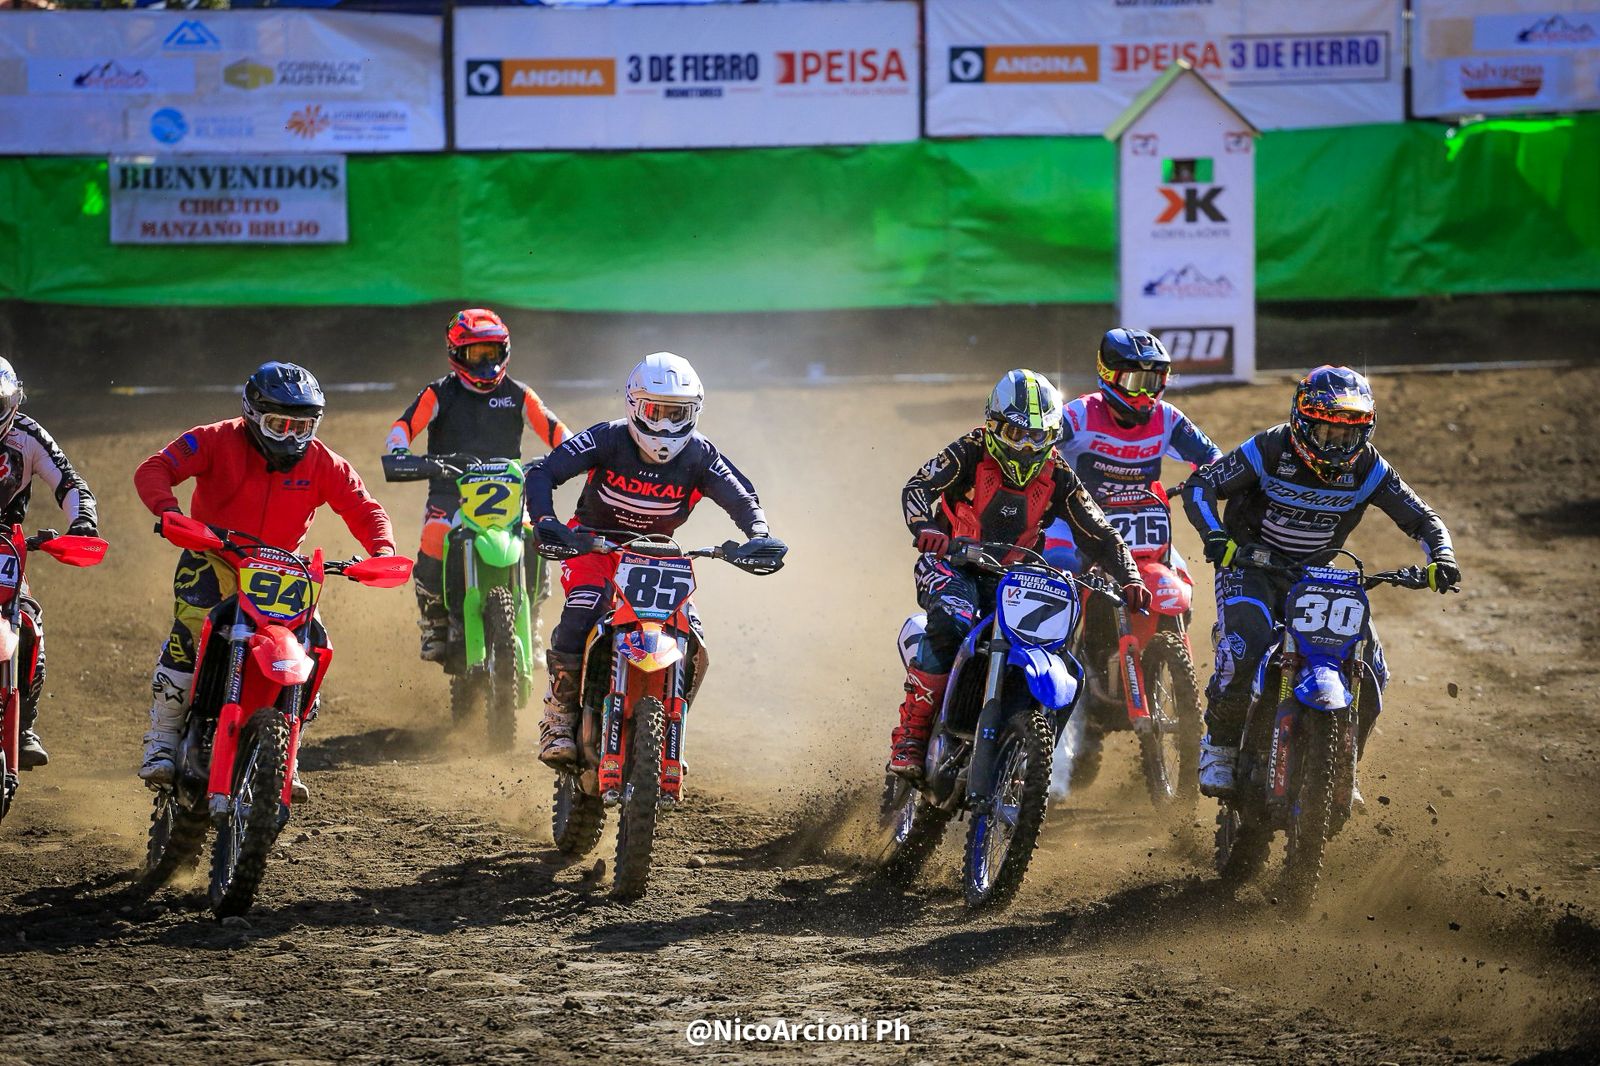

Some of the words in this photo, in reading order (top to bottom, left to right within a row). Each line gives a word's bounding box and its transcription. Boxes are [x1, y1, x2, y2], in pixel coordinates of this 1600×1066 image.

[627, 54, 642, 82] 3
[649, 54, 675, 83] DE
[682, 52, 759, 82] FIERRO
[802, 48, 908, 84] PEISA
[994, 54, 1088, 74] ANDINA
[1230, 42, 1247, 69] 3
[1256, 42, 1284, 69] DE
[1292, 38, 1380, 68] FIERRO
[277, 74, 358, 86] AUSTRAL
[510, 68, 605, 87] ANDINA
[118, 164, 339, 190] BIENVENIDOS
[178, 198, 281, 215] CIRCUITO
[140, 220, 242, 238] MANZANO
[249, 220, 320, 237] BRUJO
[1007, 413, 1028, 427] Airoh
[606, 469, 686, 499] RADIKAL
[473, 482, 511, 517] 2
[1108, 515, 1168, 545] 215
[246, 571, 308, 613] 94
[623, 566, 692, 611] 85
[1011, 573, 1048, 585] JAVIER
[1020, 580, 1068, 597] VENIALGO
[1305, 585, 1357, 597] BLANC
[1016, 590, 1070, 633] 7
[1291, 593, 1366, 637] 30
[169, 632, 193, 664] FOX
[1269, 726, 1280, 789] DUNLOP
